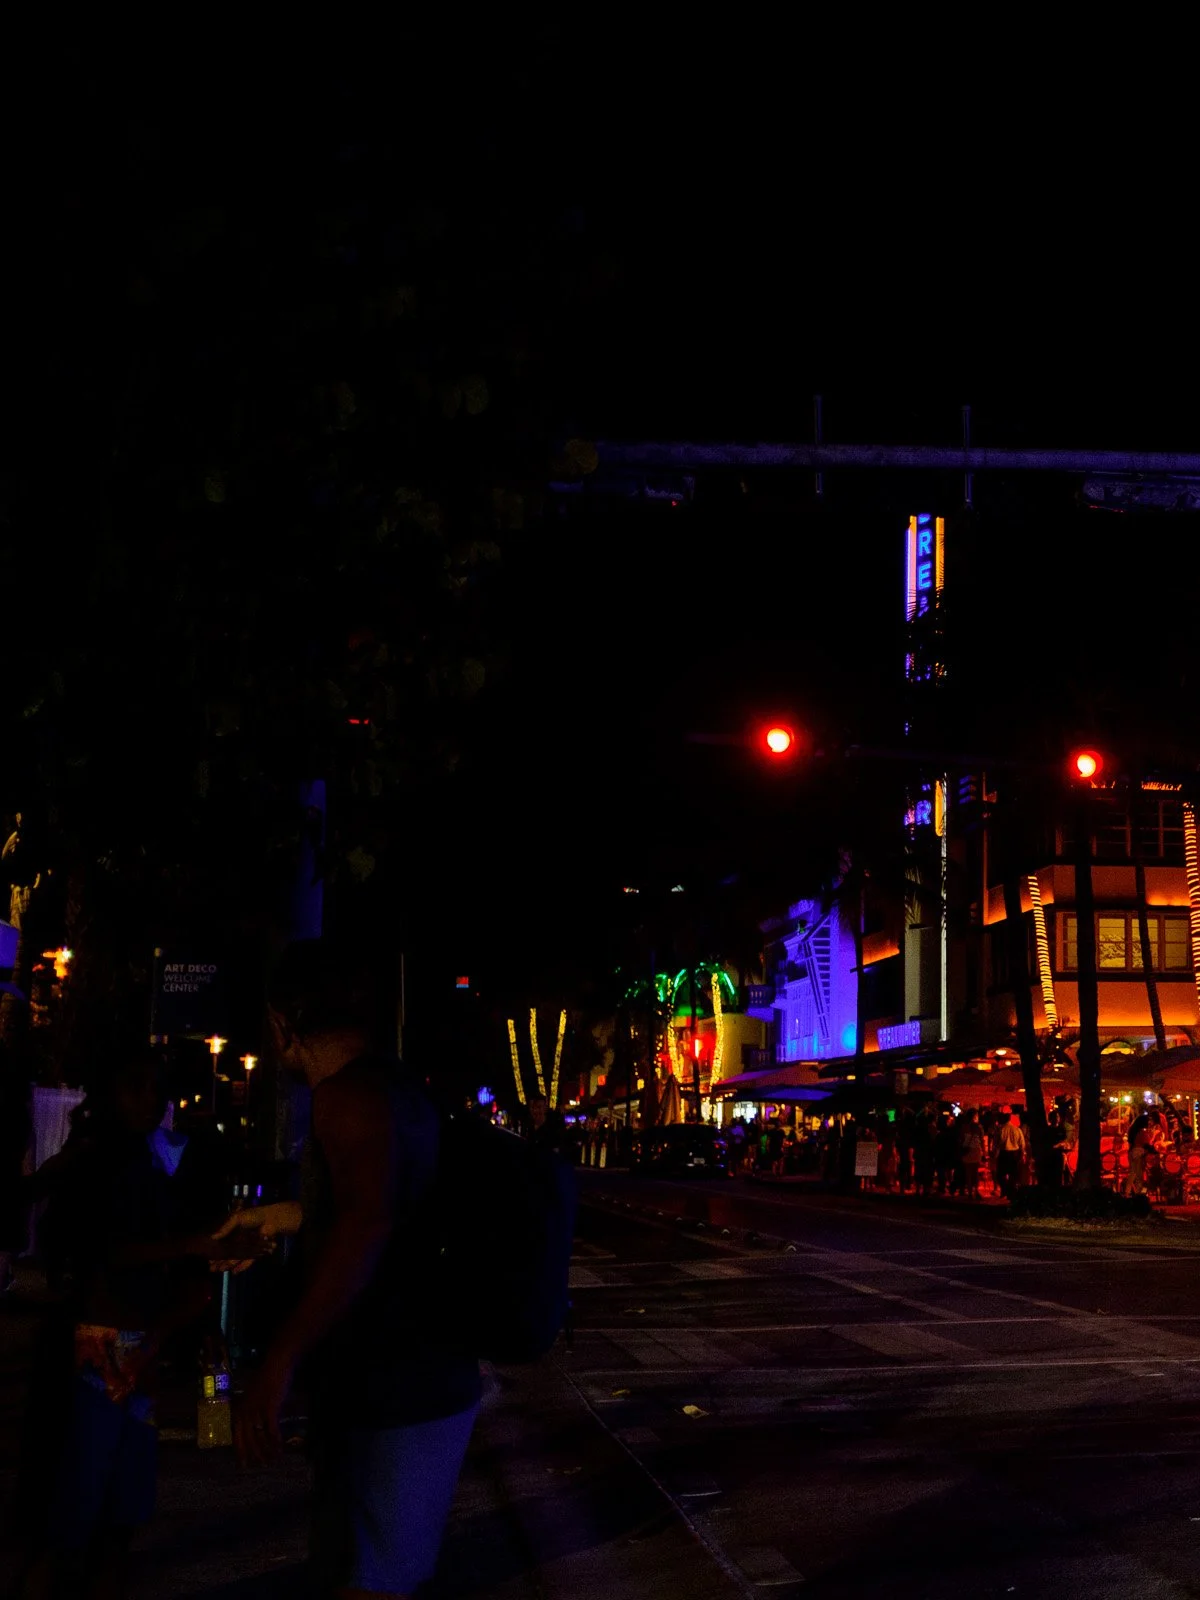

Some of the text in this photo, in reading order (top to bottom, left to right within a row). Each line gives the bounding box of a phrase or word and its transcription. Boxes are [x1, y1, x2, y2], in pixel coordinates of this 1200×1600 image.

[164, 963, 217, 973] ART DECO
[163, 983, 199, 992] CENTER
